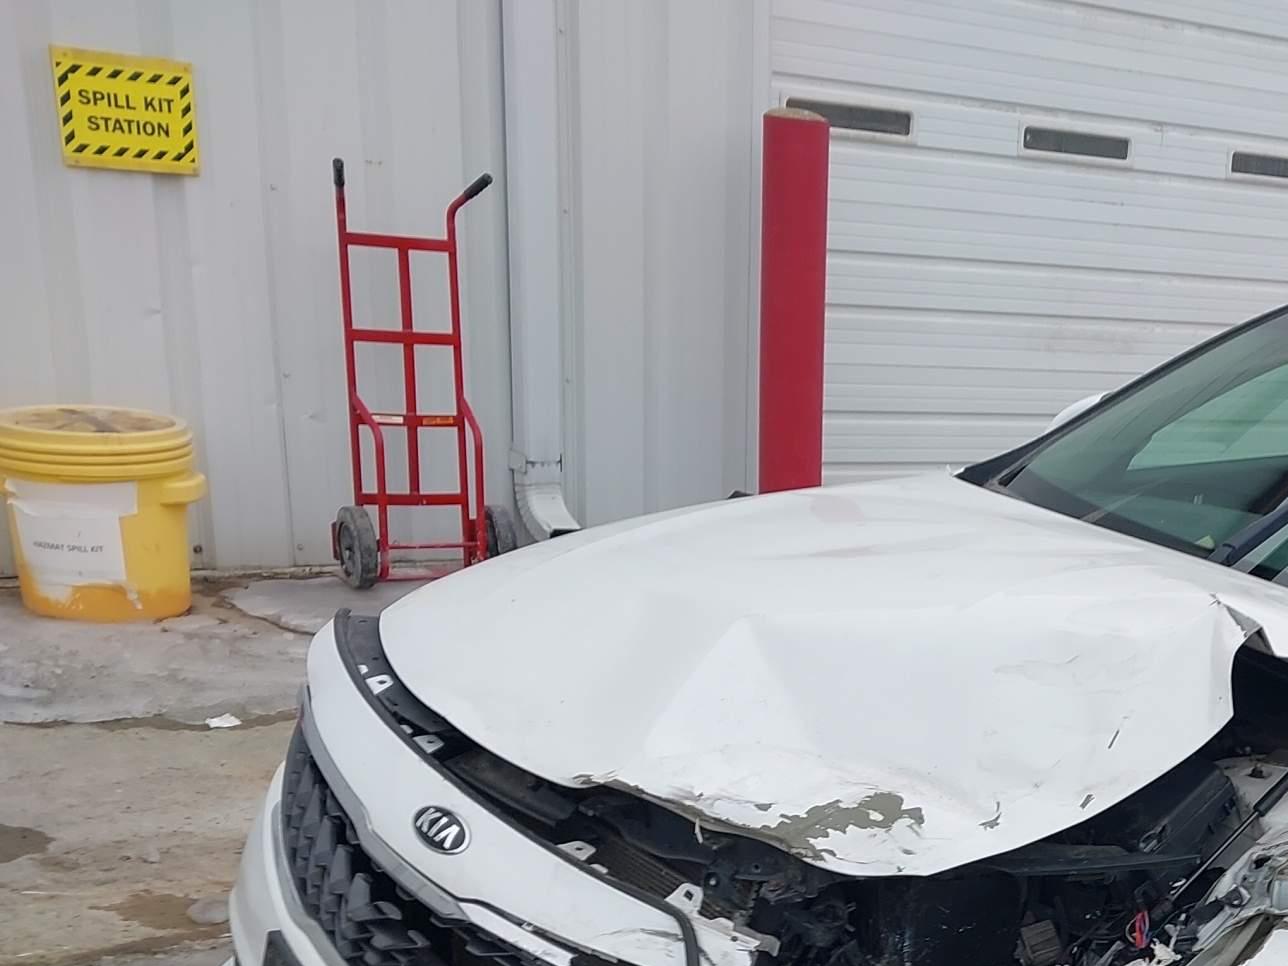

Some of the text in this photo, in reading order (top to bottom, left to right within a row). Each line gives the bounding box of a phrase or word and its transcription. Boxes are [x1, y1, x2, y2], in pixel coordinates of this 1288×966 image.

[78, 89, 174, 113] SPILL KIT
[87, 115, 170, 137] STATION
[66, 544, 88, 553] SPILL
[91, 545, 104, 553] KIT
[416, 807, 461, 850] KIA
